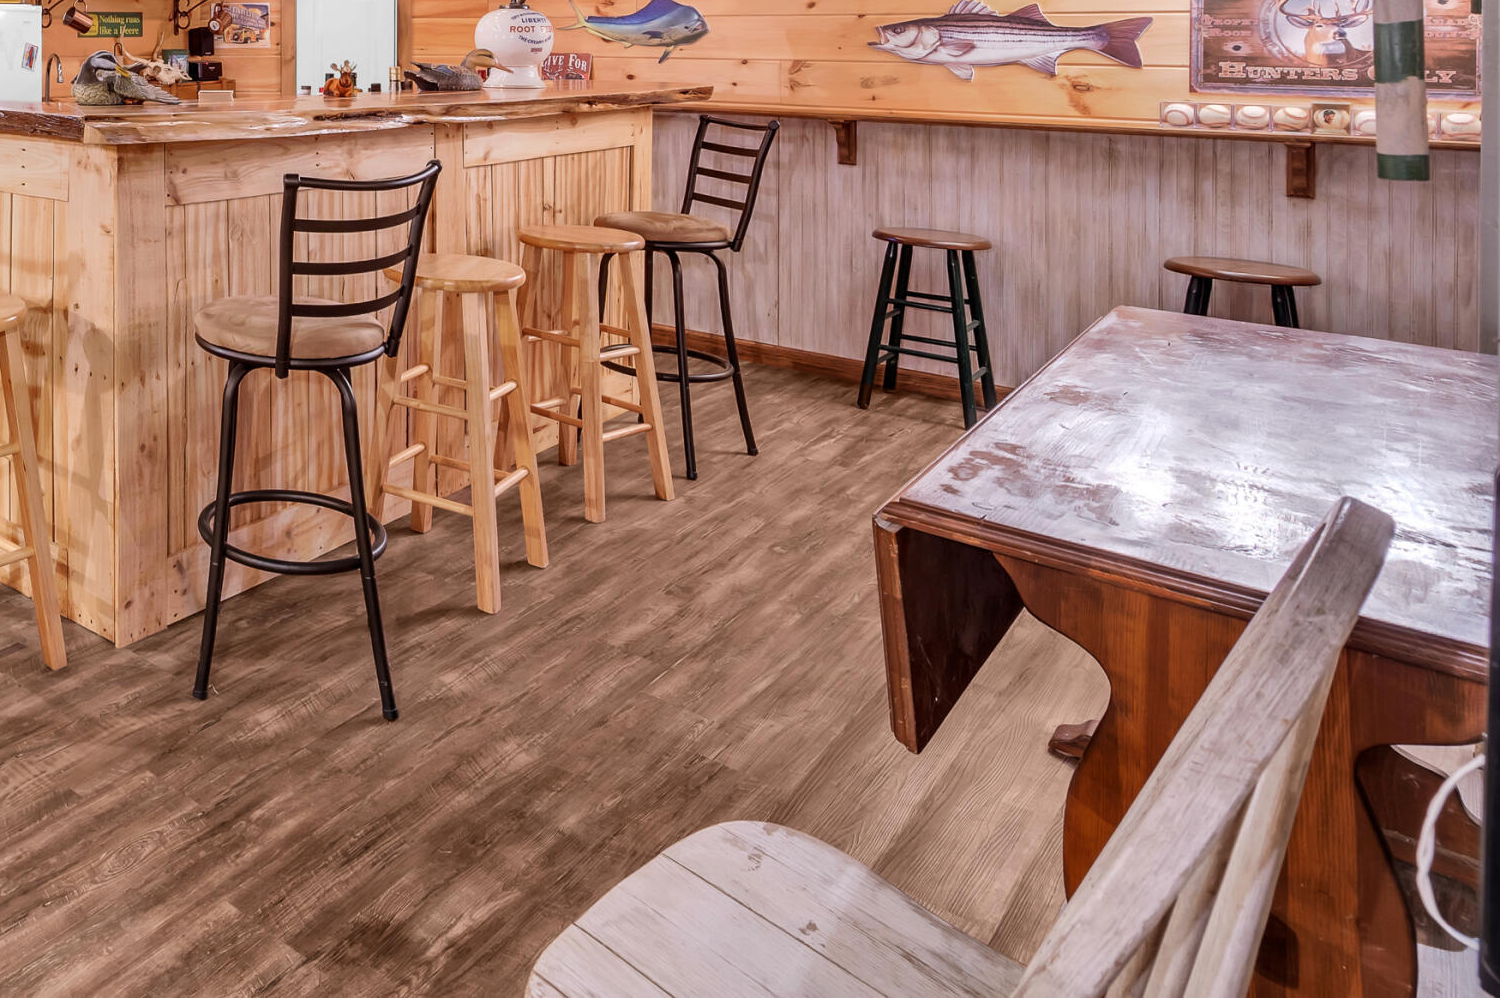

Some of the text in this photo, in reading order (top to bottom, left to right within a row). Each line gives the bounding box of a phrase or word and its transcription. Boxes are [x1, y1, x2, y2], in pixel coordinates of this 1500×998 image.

[99, 25, 112, 35] like
[509, 25, 536, 33] ROOT
[568, 53, 587, 72] FOR
[1218, 62, 1358, 81] HUNTERS
